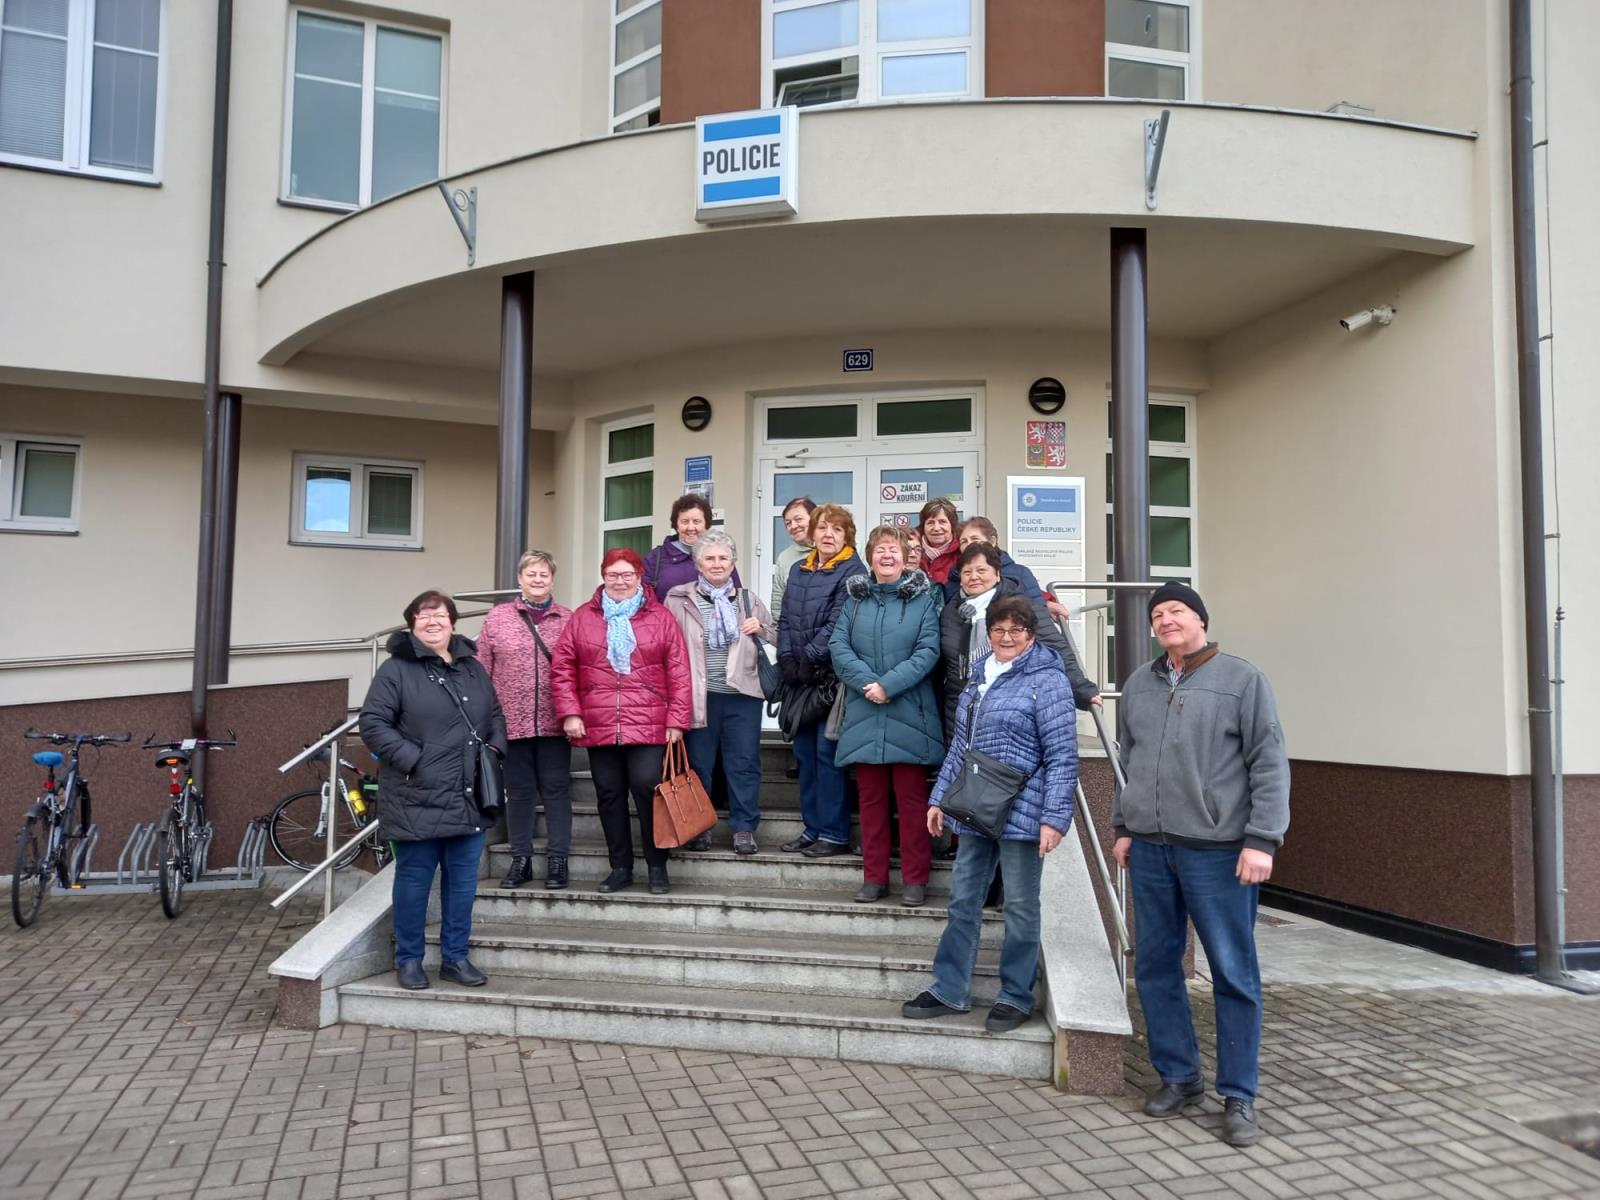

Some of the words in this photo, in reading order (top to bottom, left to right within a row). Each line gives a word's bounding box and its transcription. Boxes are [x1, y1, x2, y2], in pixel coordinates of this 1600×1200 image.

[703, 143, 781, 175] POLICIE
[848, 354, 868, 366] 629
[900, 483, 922, 492] ZÁKAZ
[896, 492, 926, 502] KOUŘENÍ
[1017, 525, 1039, 533] ČESKÉ
